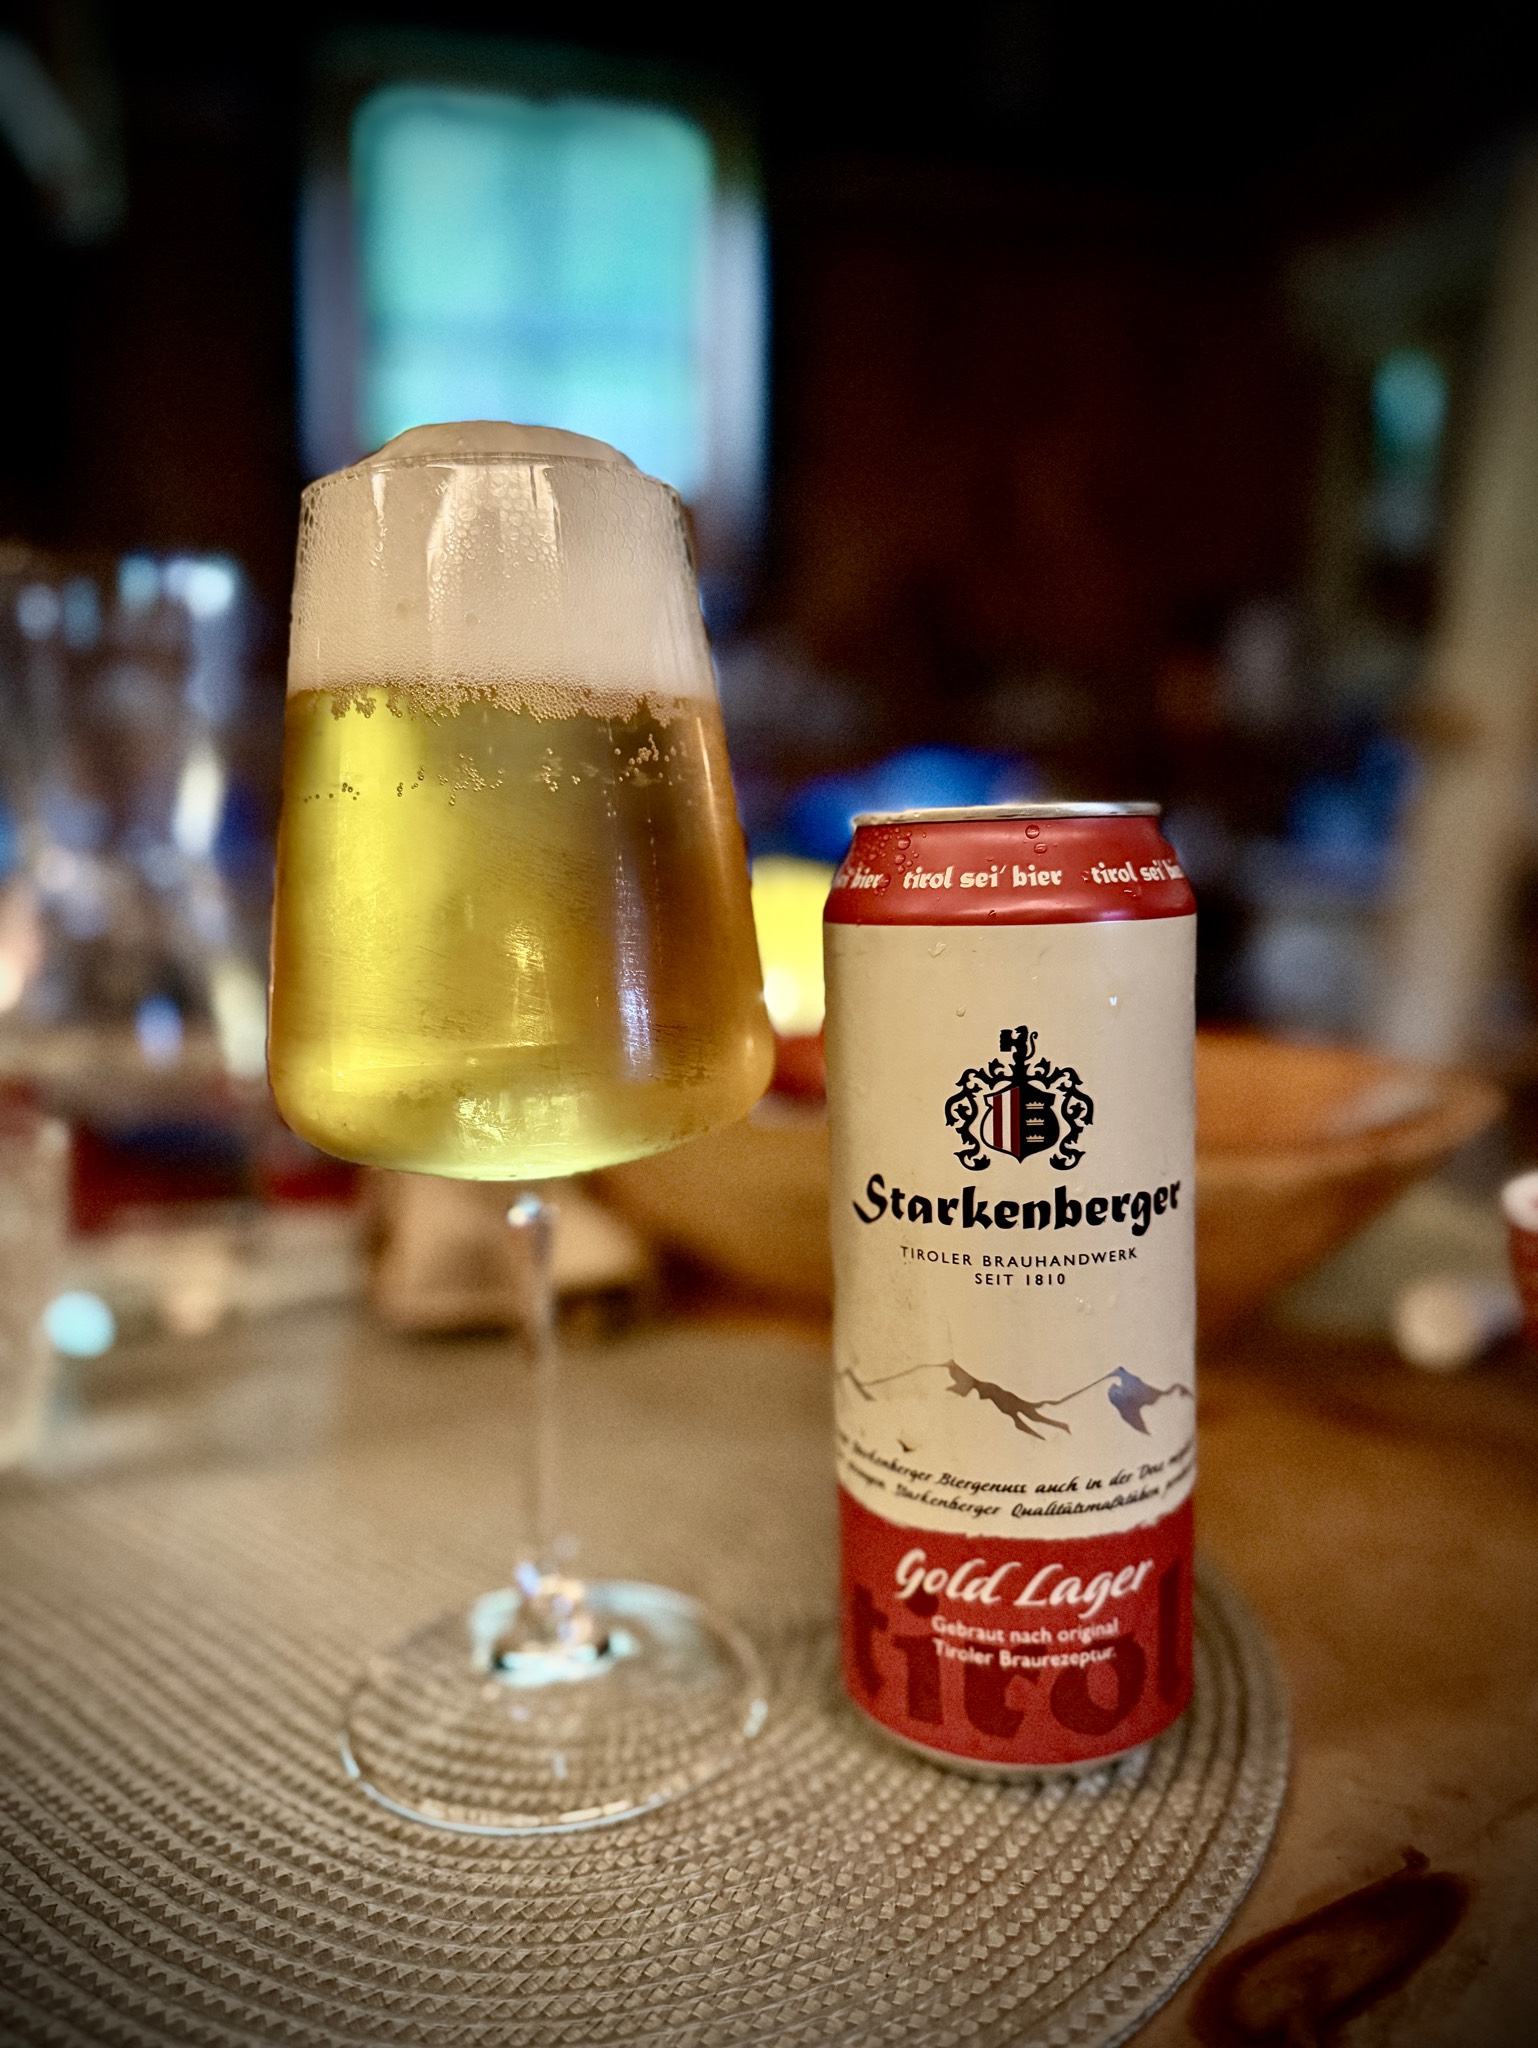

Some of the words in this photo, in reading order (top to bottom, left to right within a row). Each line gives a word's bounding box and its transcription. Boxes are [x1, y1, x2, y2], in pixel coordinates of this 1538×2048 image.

[902, 865, 954, 889] tirol
[1012, 864, 1063, 888] bier
[1091, 861, 1138, 884] tirol
[853, 1173, 1181, 1237] Starkenberger
[900, 1245, 973, 1267] TIROLER
[982, 1247, 1138, 1268] BRAUHANDWERK
[975, 1273, 1013, 1286] SEIT
[1025, 1273, 1066, 1286] 1810
[936, 1472, 1028, 1497] Biergenuss
[1035, 1475, 1080, 1494] auch
[1085, 1478, 1102, 1491] in
[1109, 1468, 1134, 1487] der
[894, 1547, 1022, 1606] Gold
[1013, 1558, 1154, 1620] Lager
[931, 1614, 1006, 1643] Gebraut
[1009, 1626, 1053, 1645] nach
[1056, 1616, 1120, 1645] original
[932, 1636, 995, 1666] Tiroler
